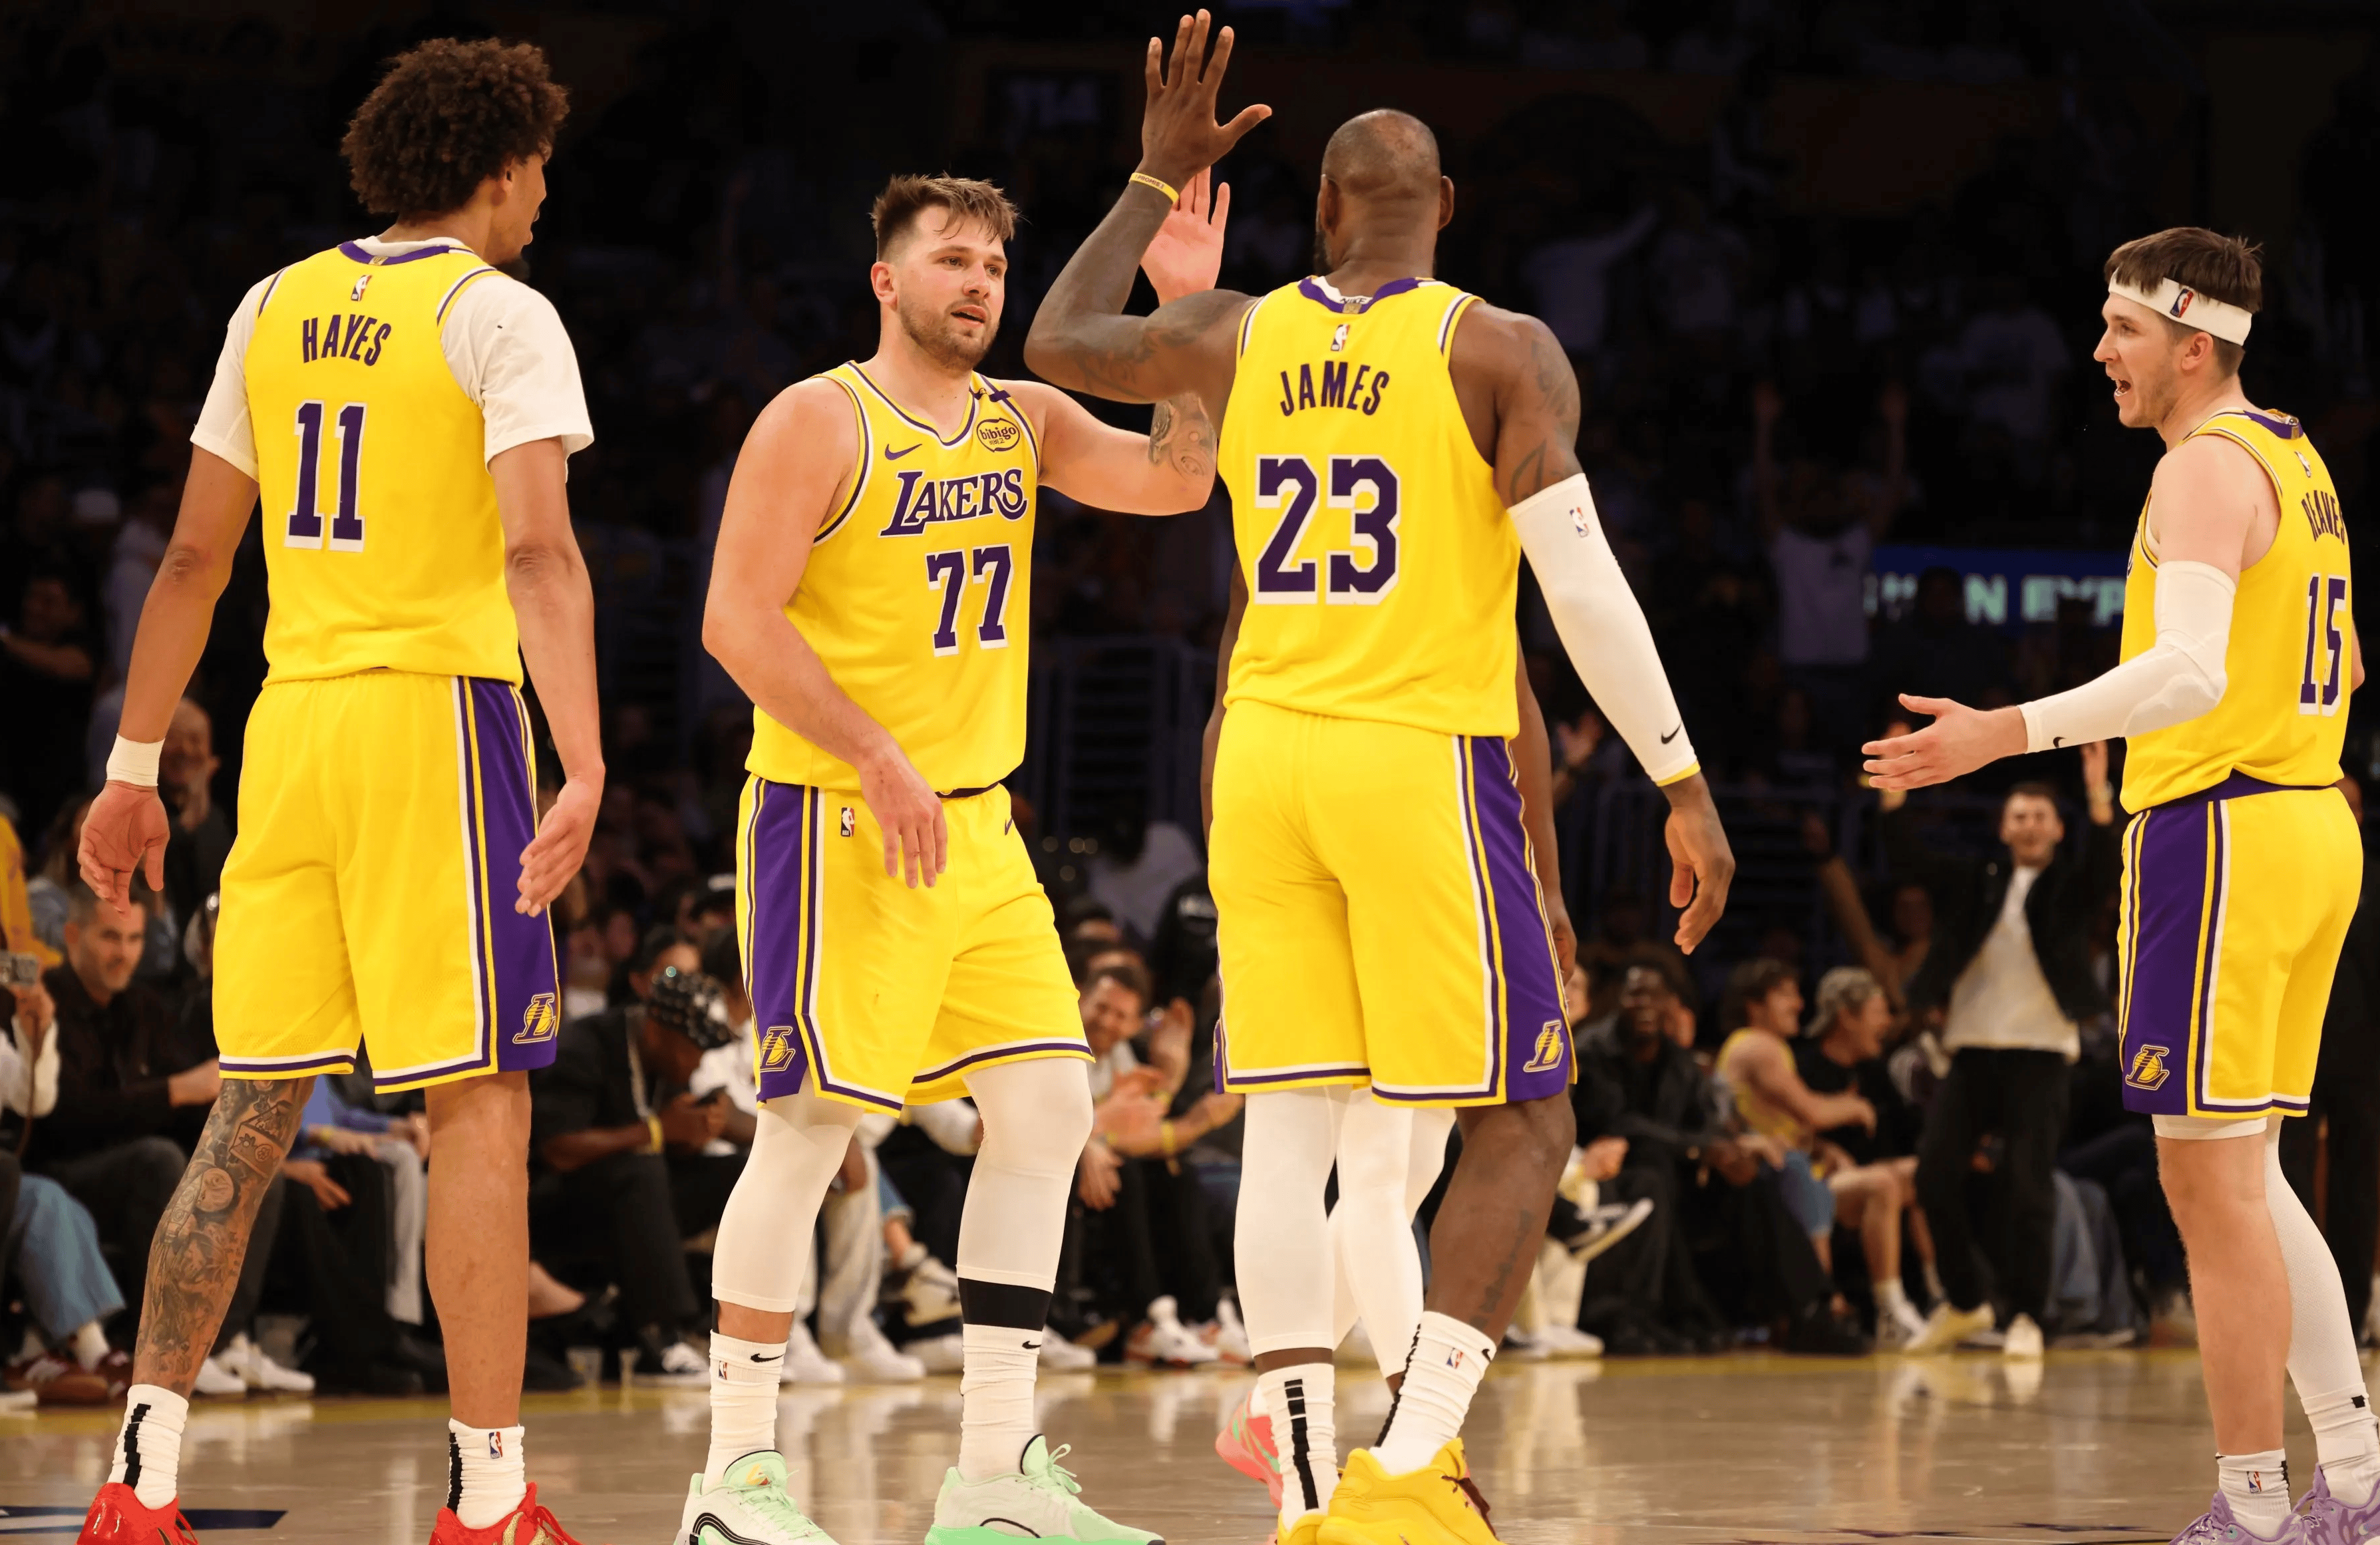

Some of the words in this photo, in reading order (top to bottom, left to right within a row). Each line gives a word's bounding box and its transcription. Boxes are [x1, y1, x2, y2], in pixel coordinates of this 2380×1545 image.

[303, 314, 391, 366] HAYES
[979, 427, 1017, 440] bibigo
[1279, 360, 1390, 417] JAMES
[284, 399, 367, 552] 11
[878, 468, 1029, 539] LAKERS
[1254, 454, 1401, 605] 23
[925, 543, 1013, 657] 77
[2299, 572, 2347, 717] 15
